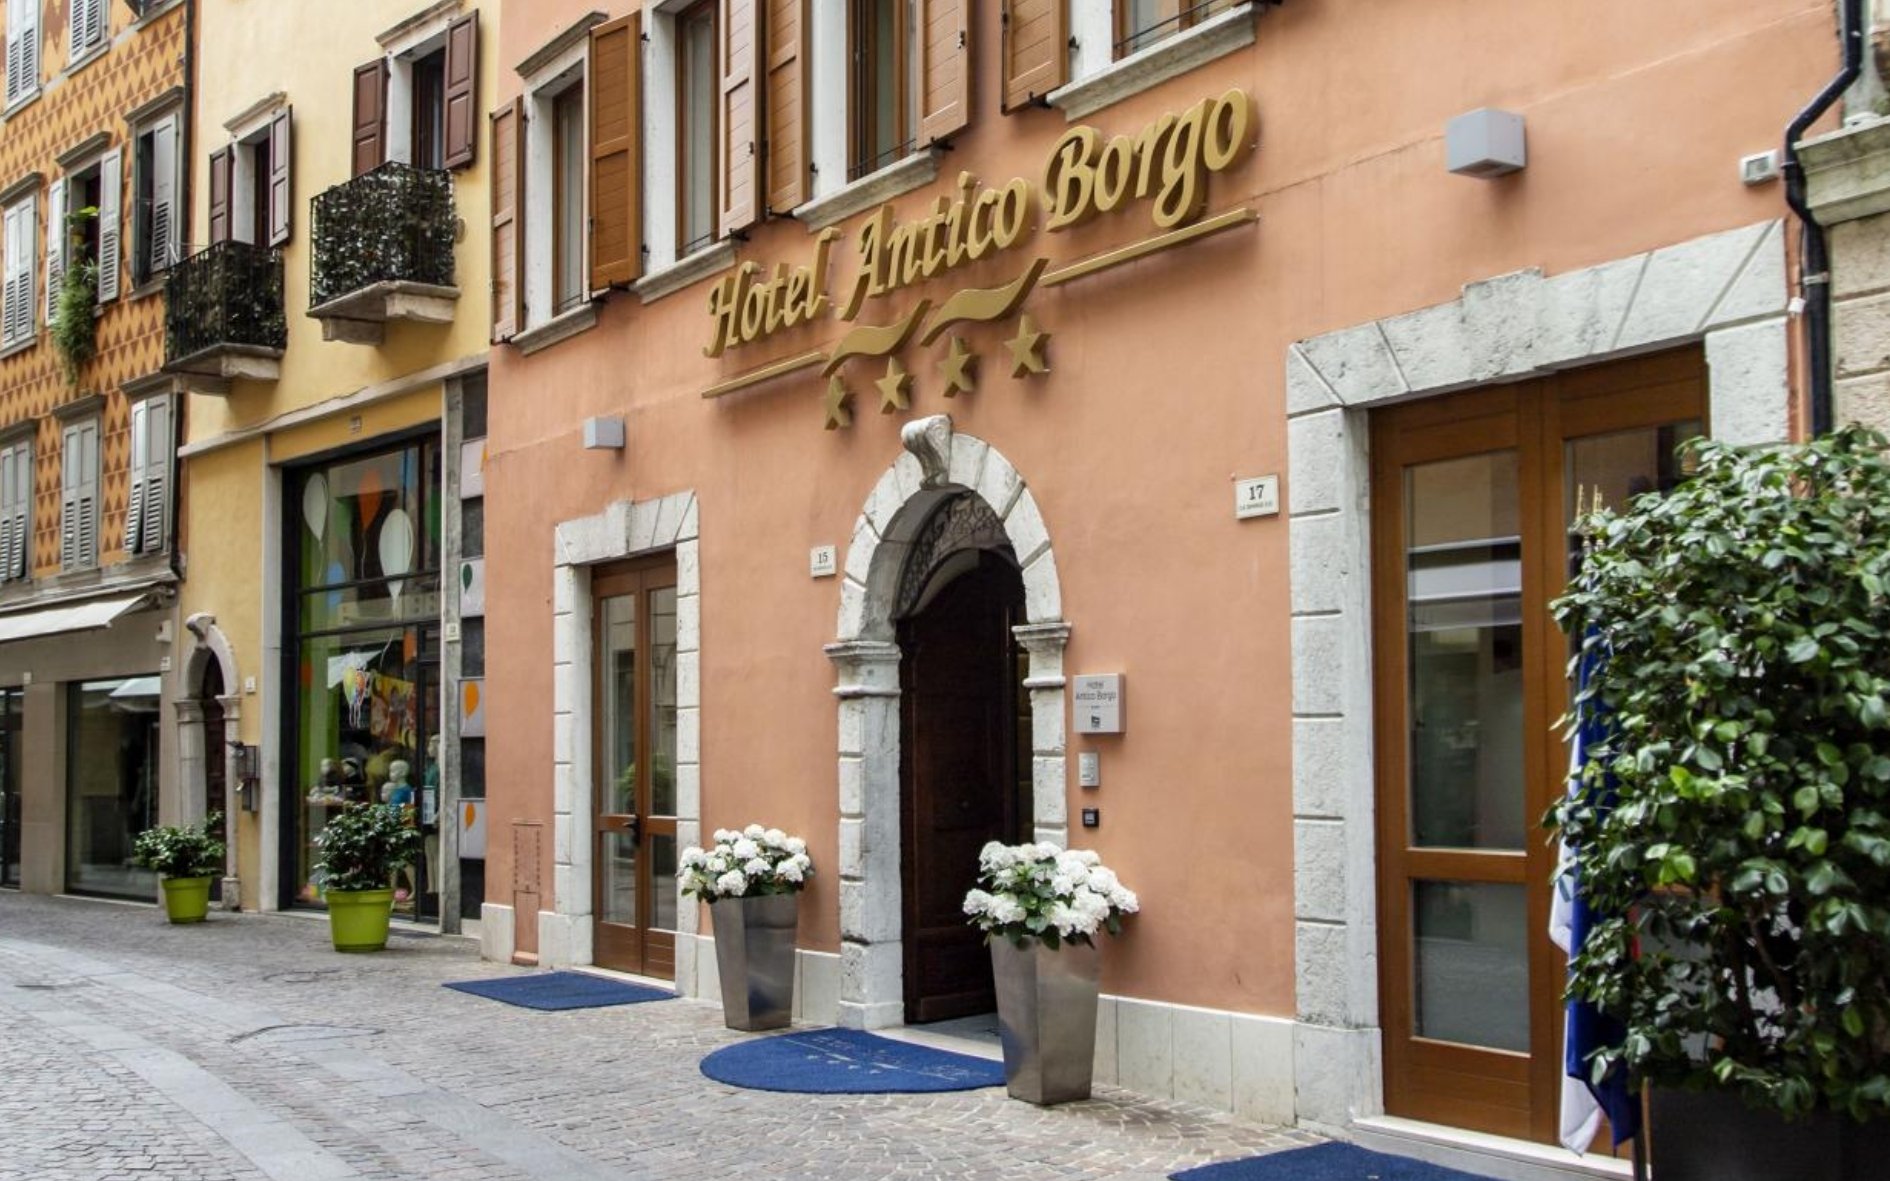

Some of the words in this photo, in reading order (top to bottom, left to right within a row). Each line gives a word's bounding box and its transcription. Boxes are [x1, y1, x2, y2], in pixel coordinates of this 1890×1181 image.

[703, 226, 841, 358] Hotel
[837, 170, 1036, 322] Antico
[1042, 87, 1255, 230] Borgo
[1249, 484, 1265, 500] 17
[818, 551, 829, 564] 15
